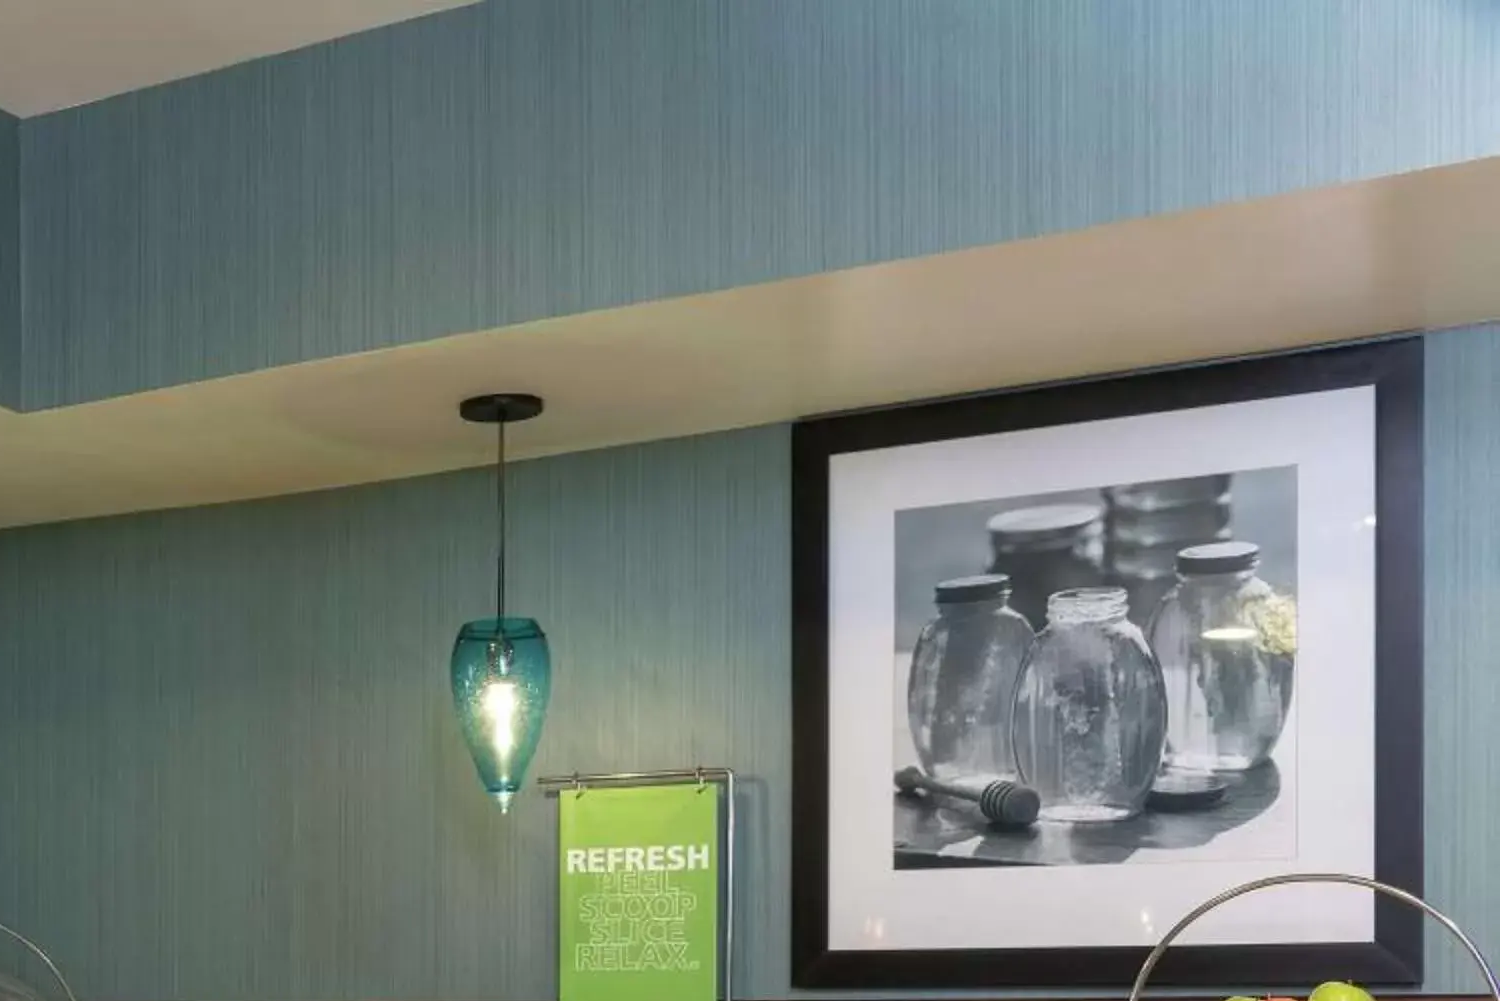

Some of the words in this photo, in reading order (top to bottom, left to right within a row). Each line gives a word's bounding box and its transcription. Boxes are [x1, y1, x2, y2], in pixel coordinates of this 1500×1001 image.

[566, 844, 710, 875] REFRESH
[579, 892, 698, 922] SCOOP
[588, 917, 686, 946] SLICE
[575, 942, 701, 972] RELAX.
